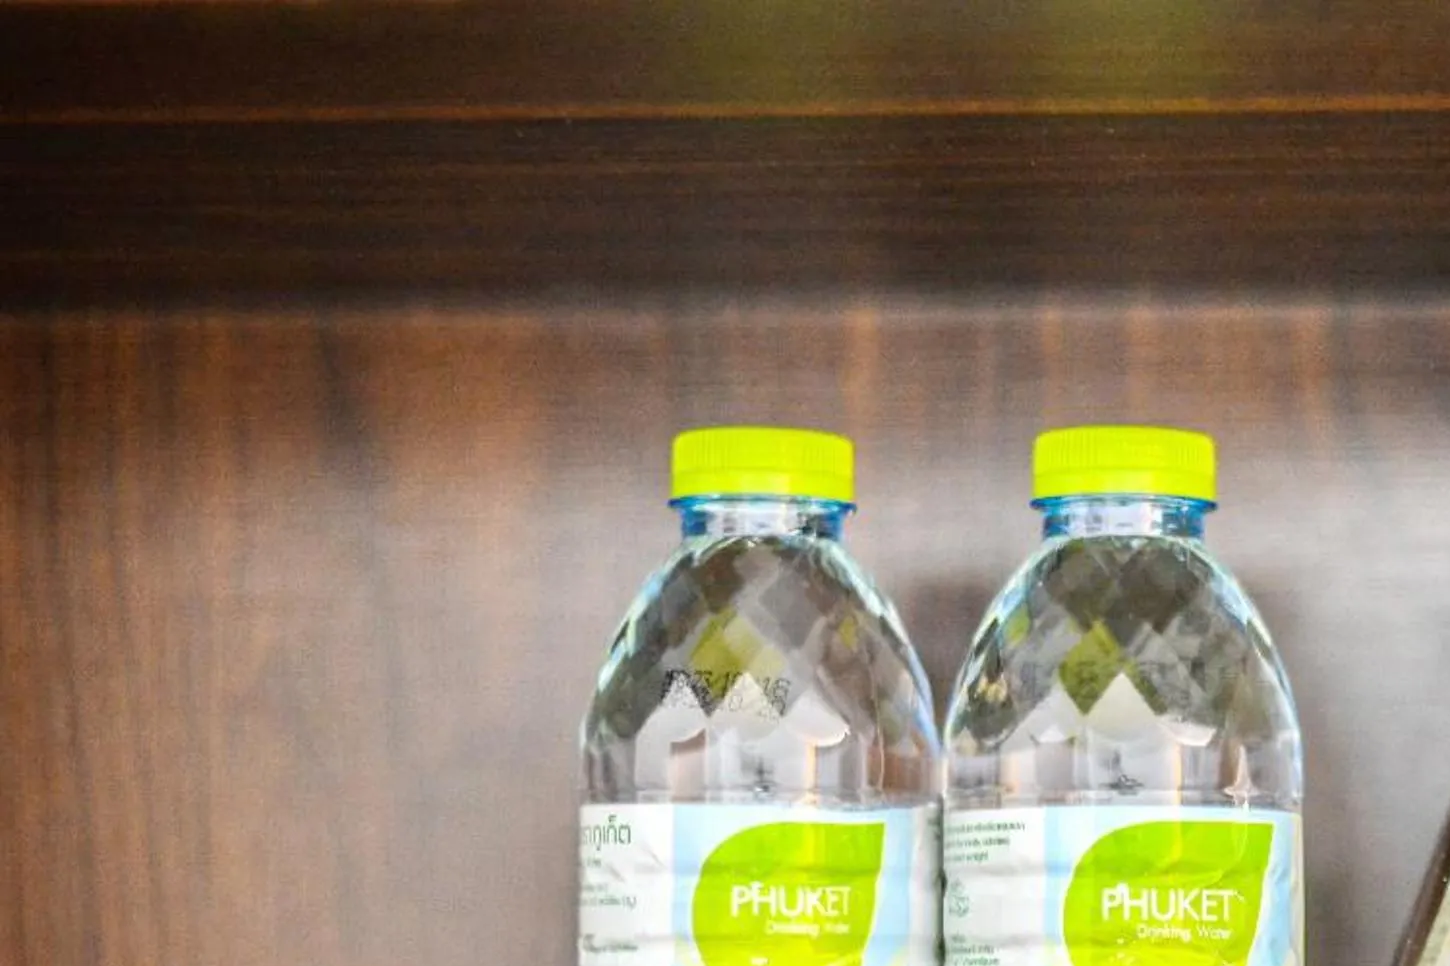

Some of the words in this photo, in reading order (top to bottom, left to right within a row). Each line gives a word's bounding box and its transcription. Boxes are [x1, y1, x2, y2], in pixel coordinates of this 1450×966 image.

[731, 880, 851, 919] PHUKET
[1101, 882, 1233, 922] PHUKET
[1136, 922, 1192, 944] Drinking
